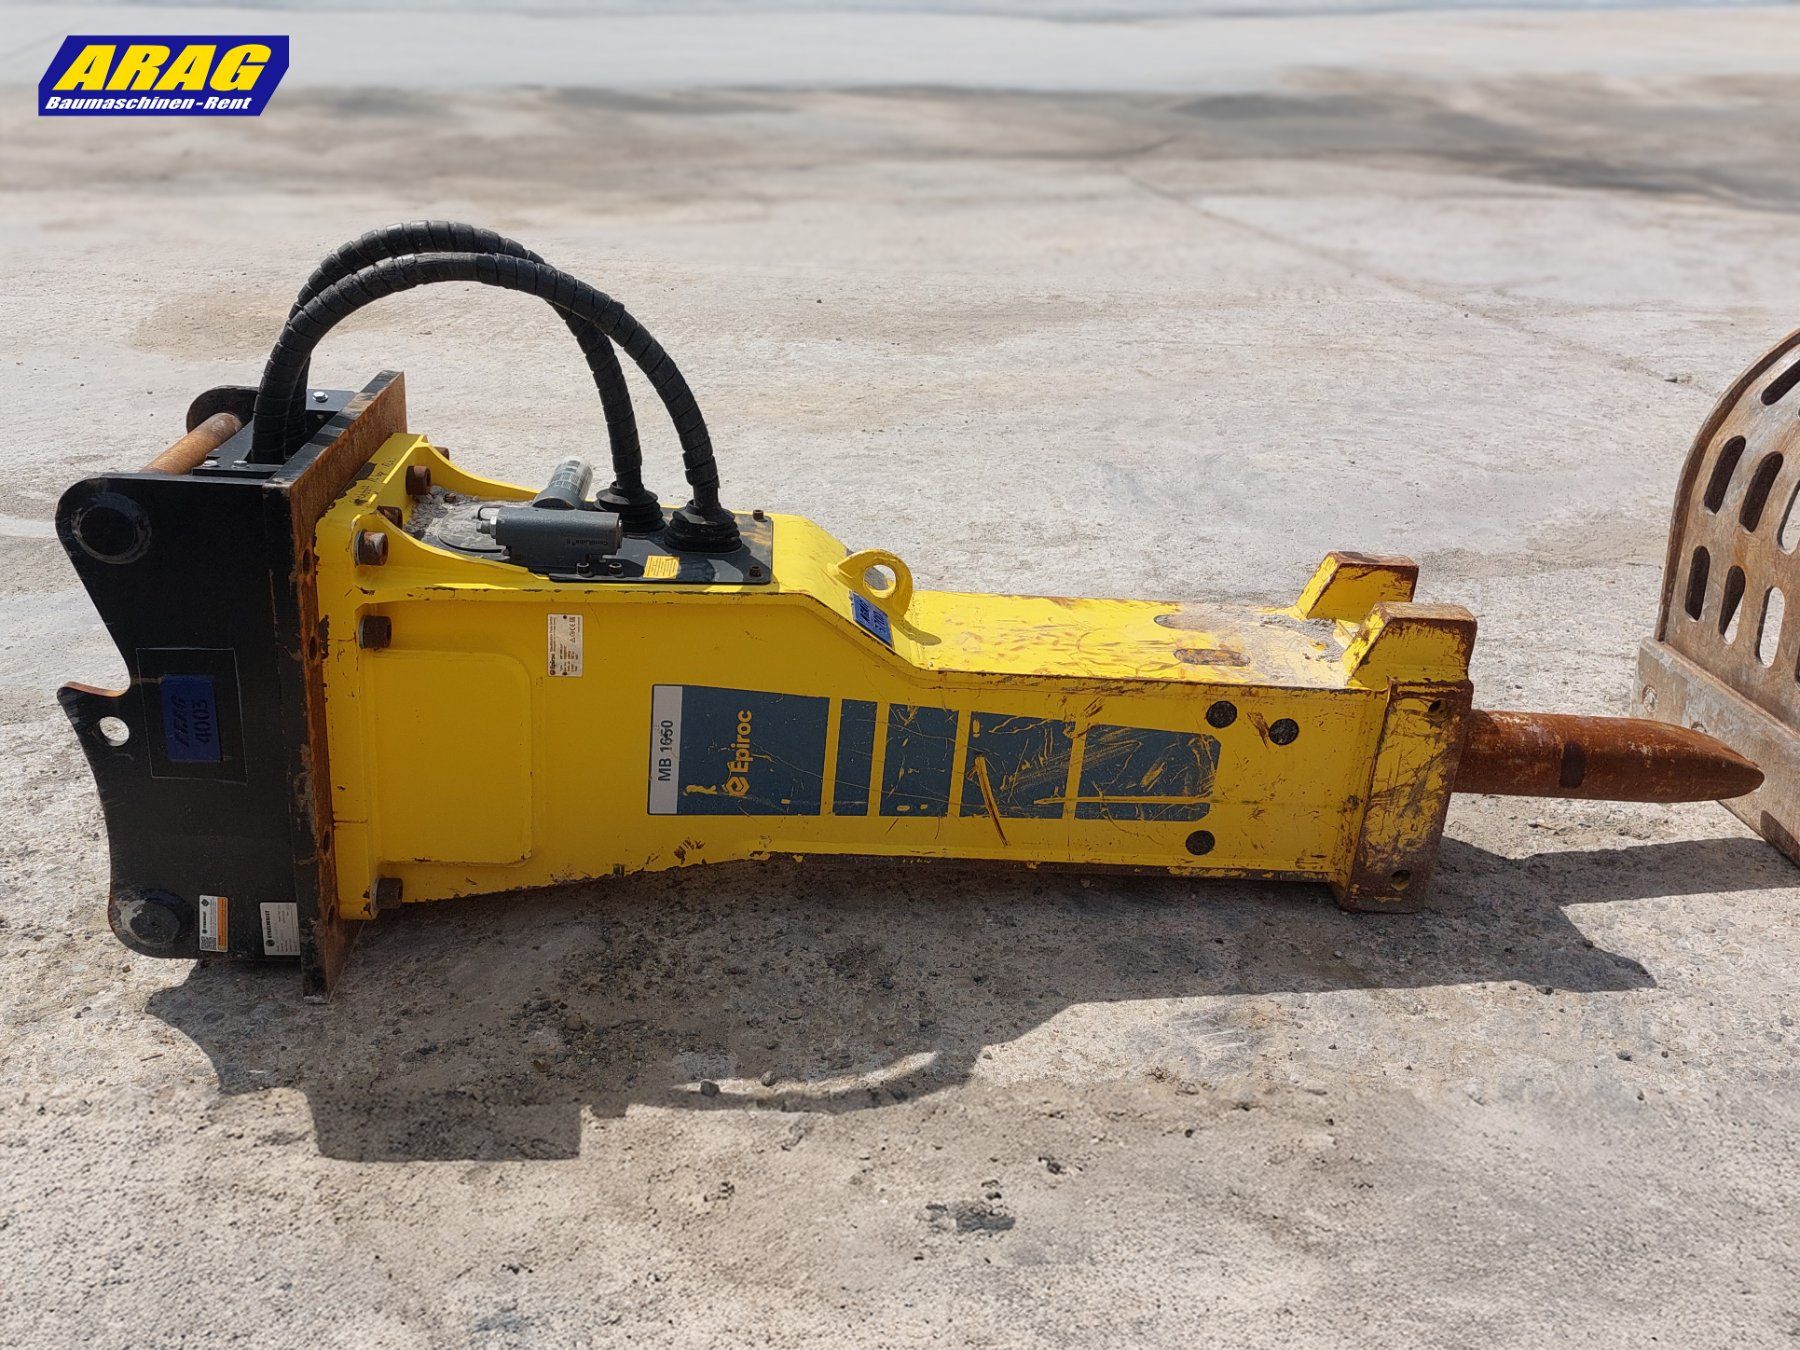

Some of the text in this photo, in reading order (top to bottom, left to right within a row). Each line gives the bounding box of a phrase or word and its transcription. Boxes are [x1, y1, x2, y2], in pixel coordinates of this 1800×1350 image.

[191, 699, 212, 743] 4003
[657, 719, 674, 782] MB 1650
[726, 709, 754, 773] Epiroc
